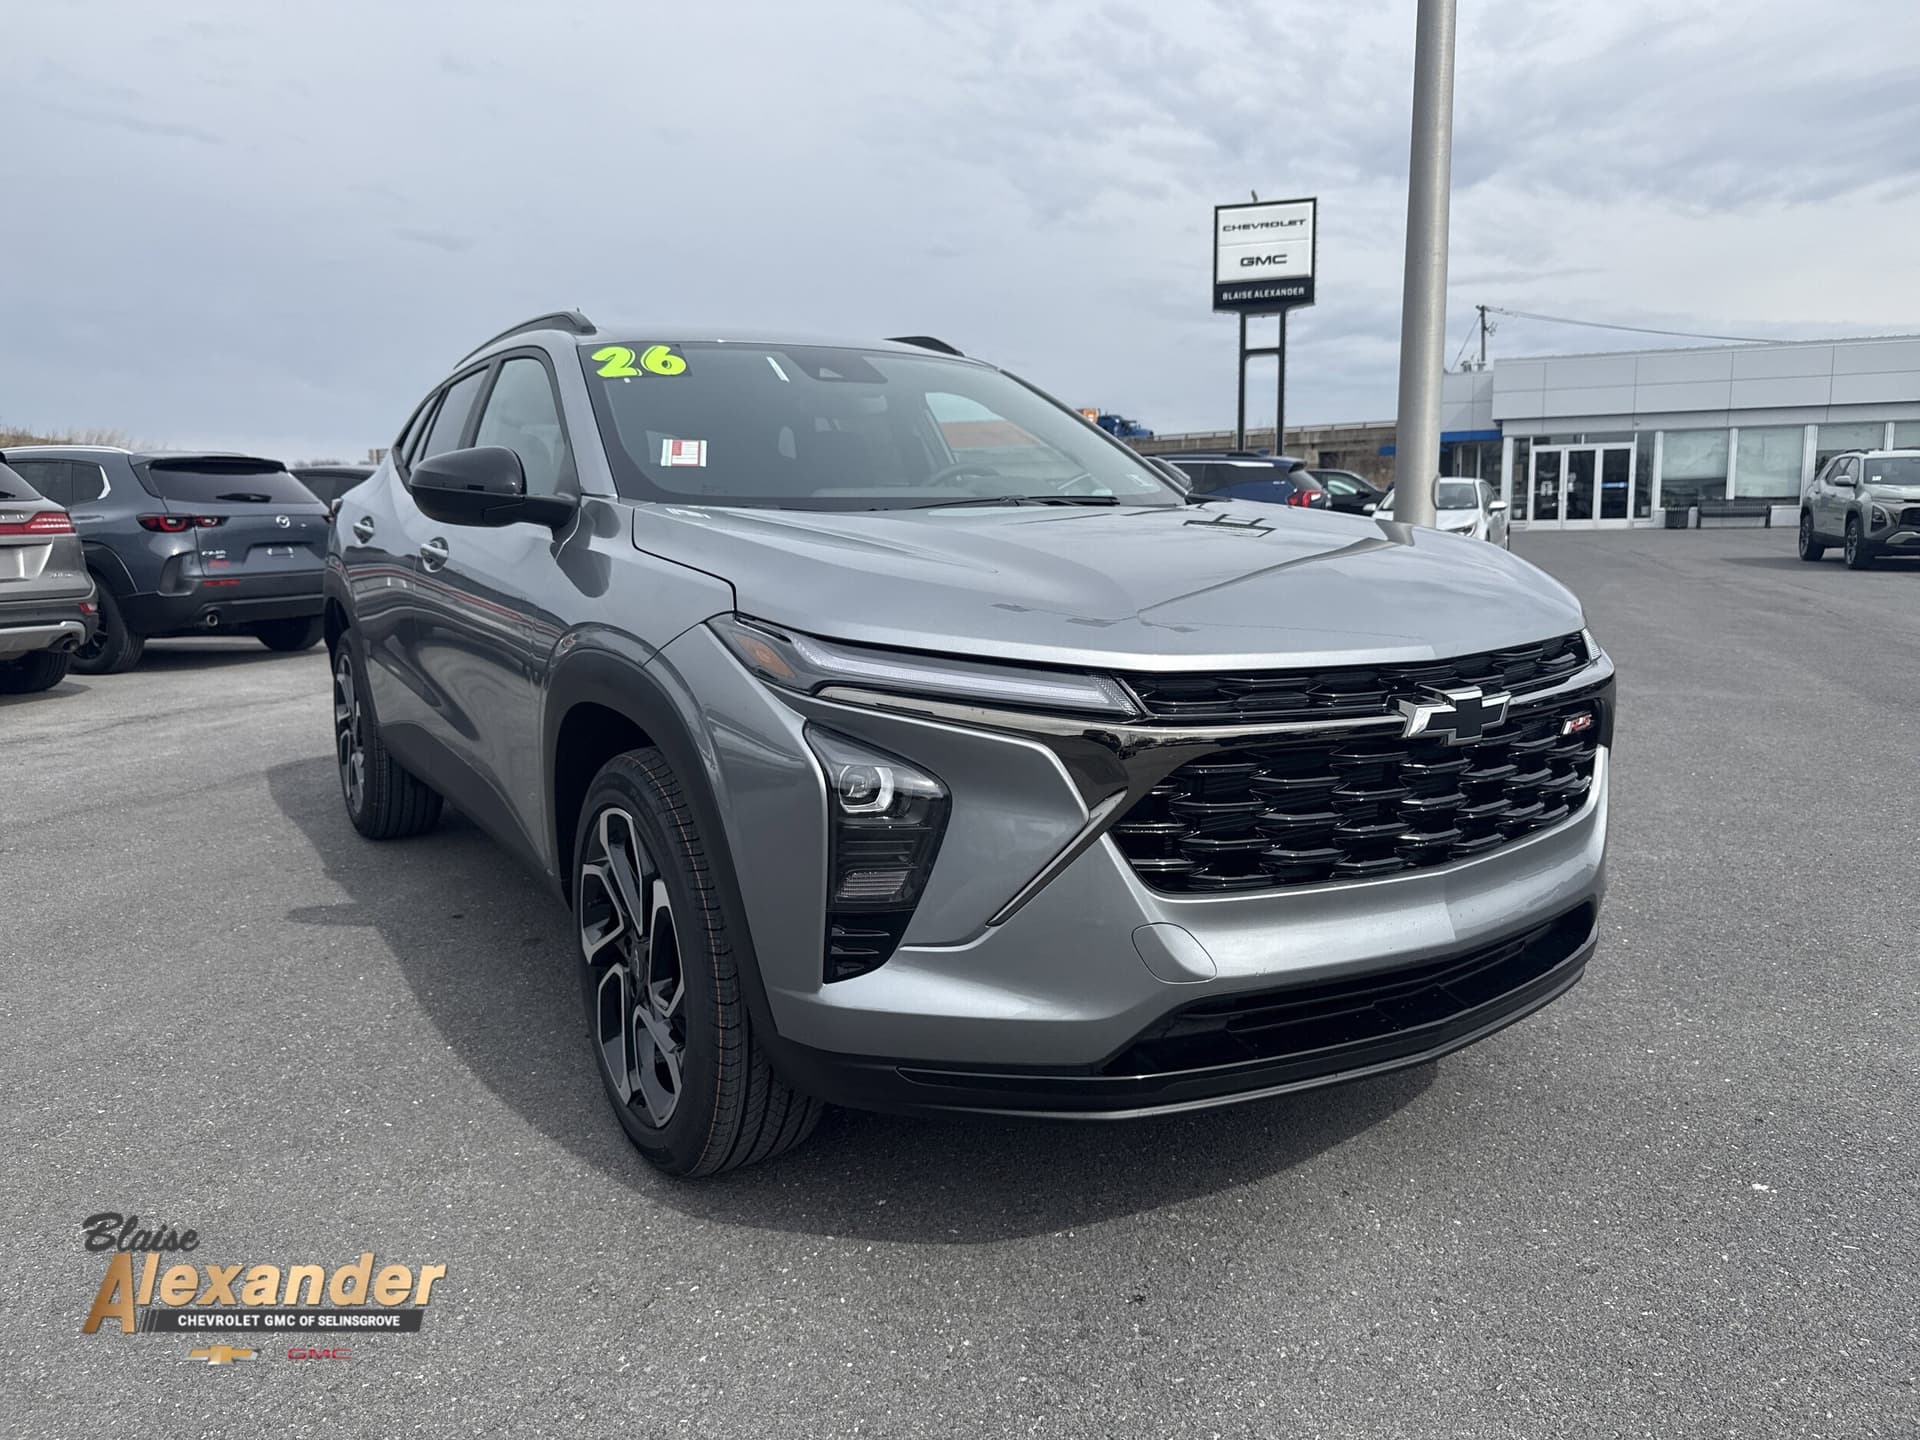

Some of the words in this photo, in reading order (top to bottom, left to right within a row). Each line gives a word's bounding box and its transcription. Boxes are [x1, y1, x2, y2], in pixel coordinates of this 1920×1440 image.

[1222, 219, 1306, 232] CHEVROLET
[1240, 254, 1288, 267] GMC
[1222, 290, 1253, 300] BLAISE
[1254, 287, 1305, 298] ALEXANDER
[591, 345, 687, 378] 26
